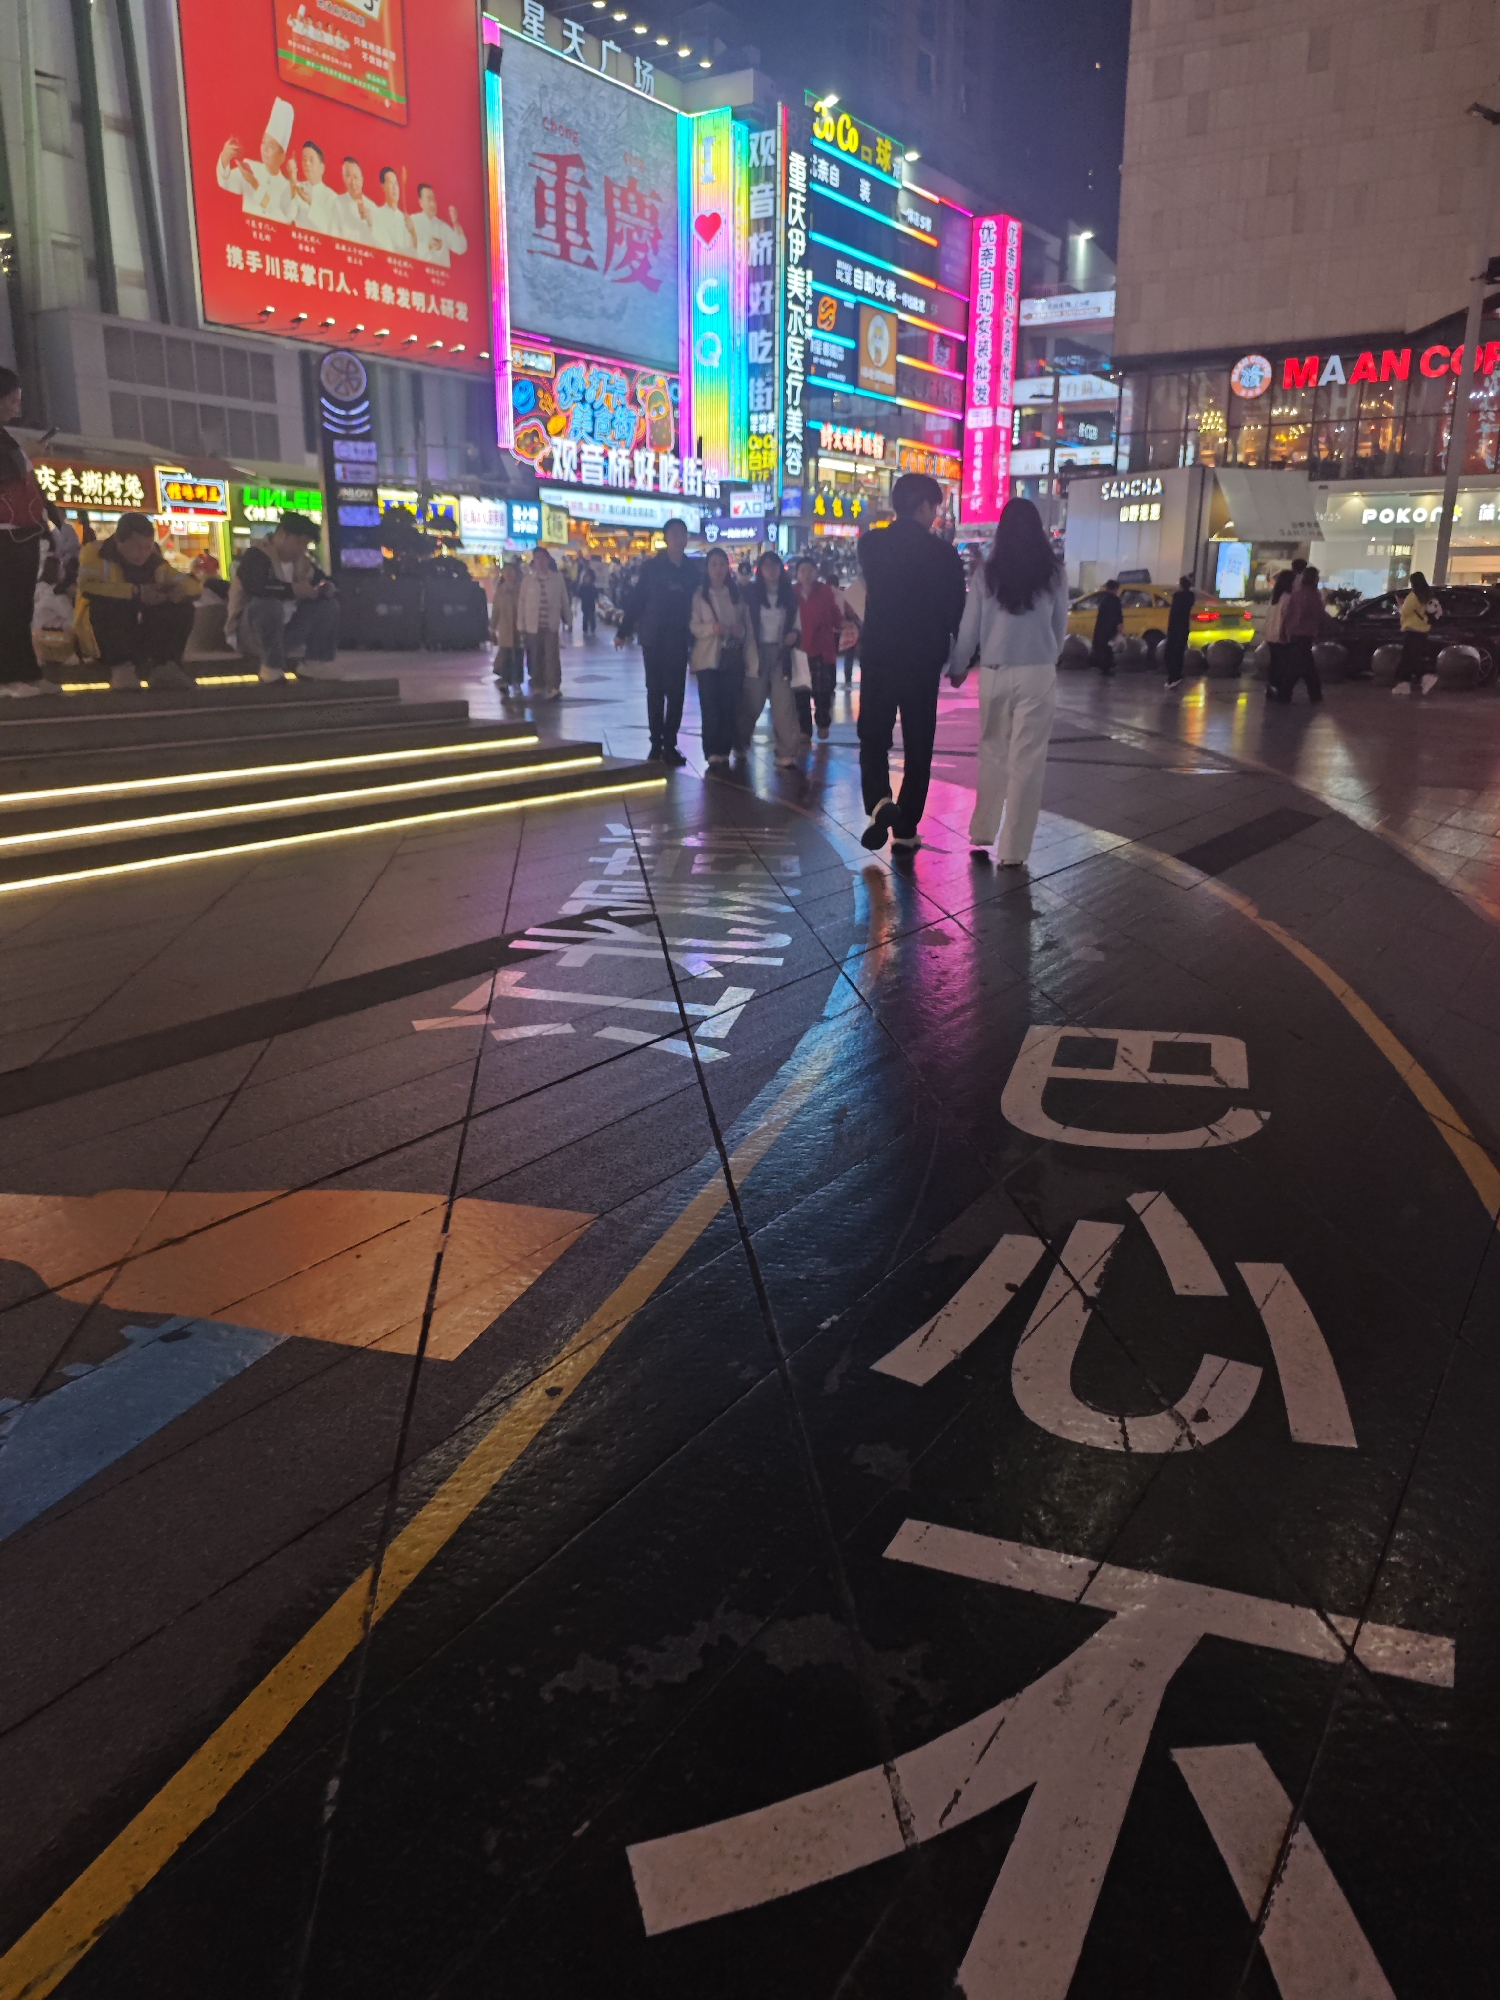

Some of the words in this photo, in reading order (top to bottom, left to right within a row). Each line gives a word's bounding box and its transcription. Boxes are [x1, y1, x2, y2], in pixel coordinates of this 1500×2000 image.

[523, 0, 655, 97] 星天广场
[542, 116, 580, 147] Chong
[700, 136, 716, 185] I
[225, 243, 469, 323] 携手川菜掌门人、辣条发明人研发
[747, 130, 777, 412] 观音桥好吃街
[785, 151, 807, 477] 重庆伊美尔医疗美容
[972, 219, 998, 406] 优奈自助女装批发
[1283, 348, 1412, 390] MAAN
[568, 401, 638, 450] 美食街
[550, 436, 704, 498] 观音桥好吃街
[748, 450, 778, 471] 台球
[63, 494, 142, 508] SHANSHAN
[742, 501, 763, 515] 入口
[1101, 477, 1164, 501] SANCHA
